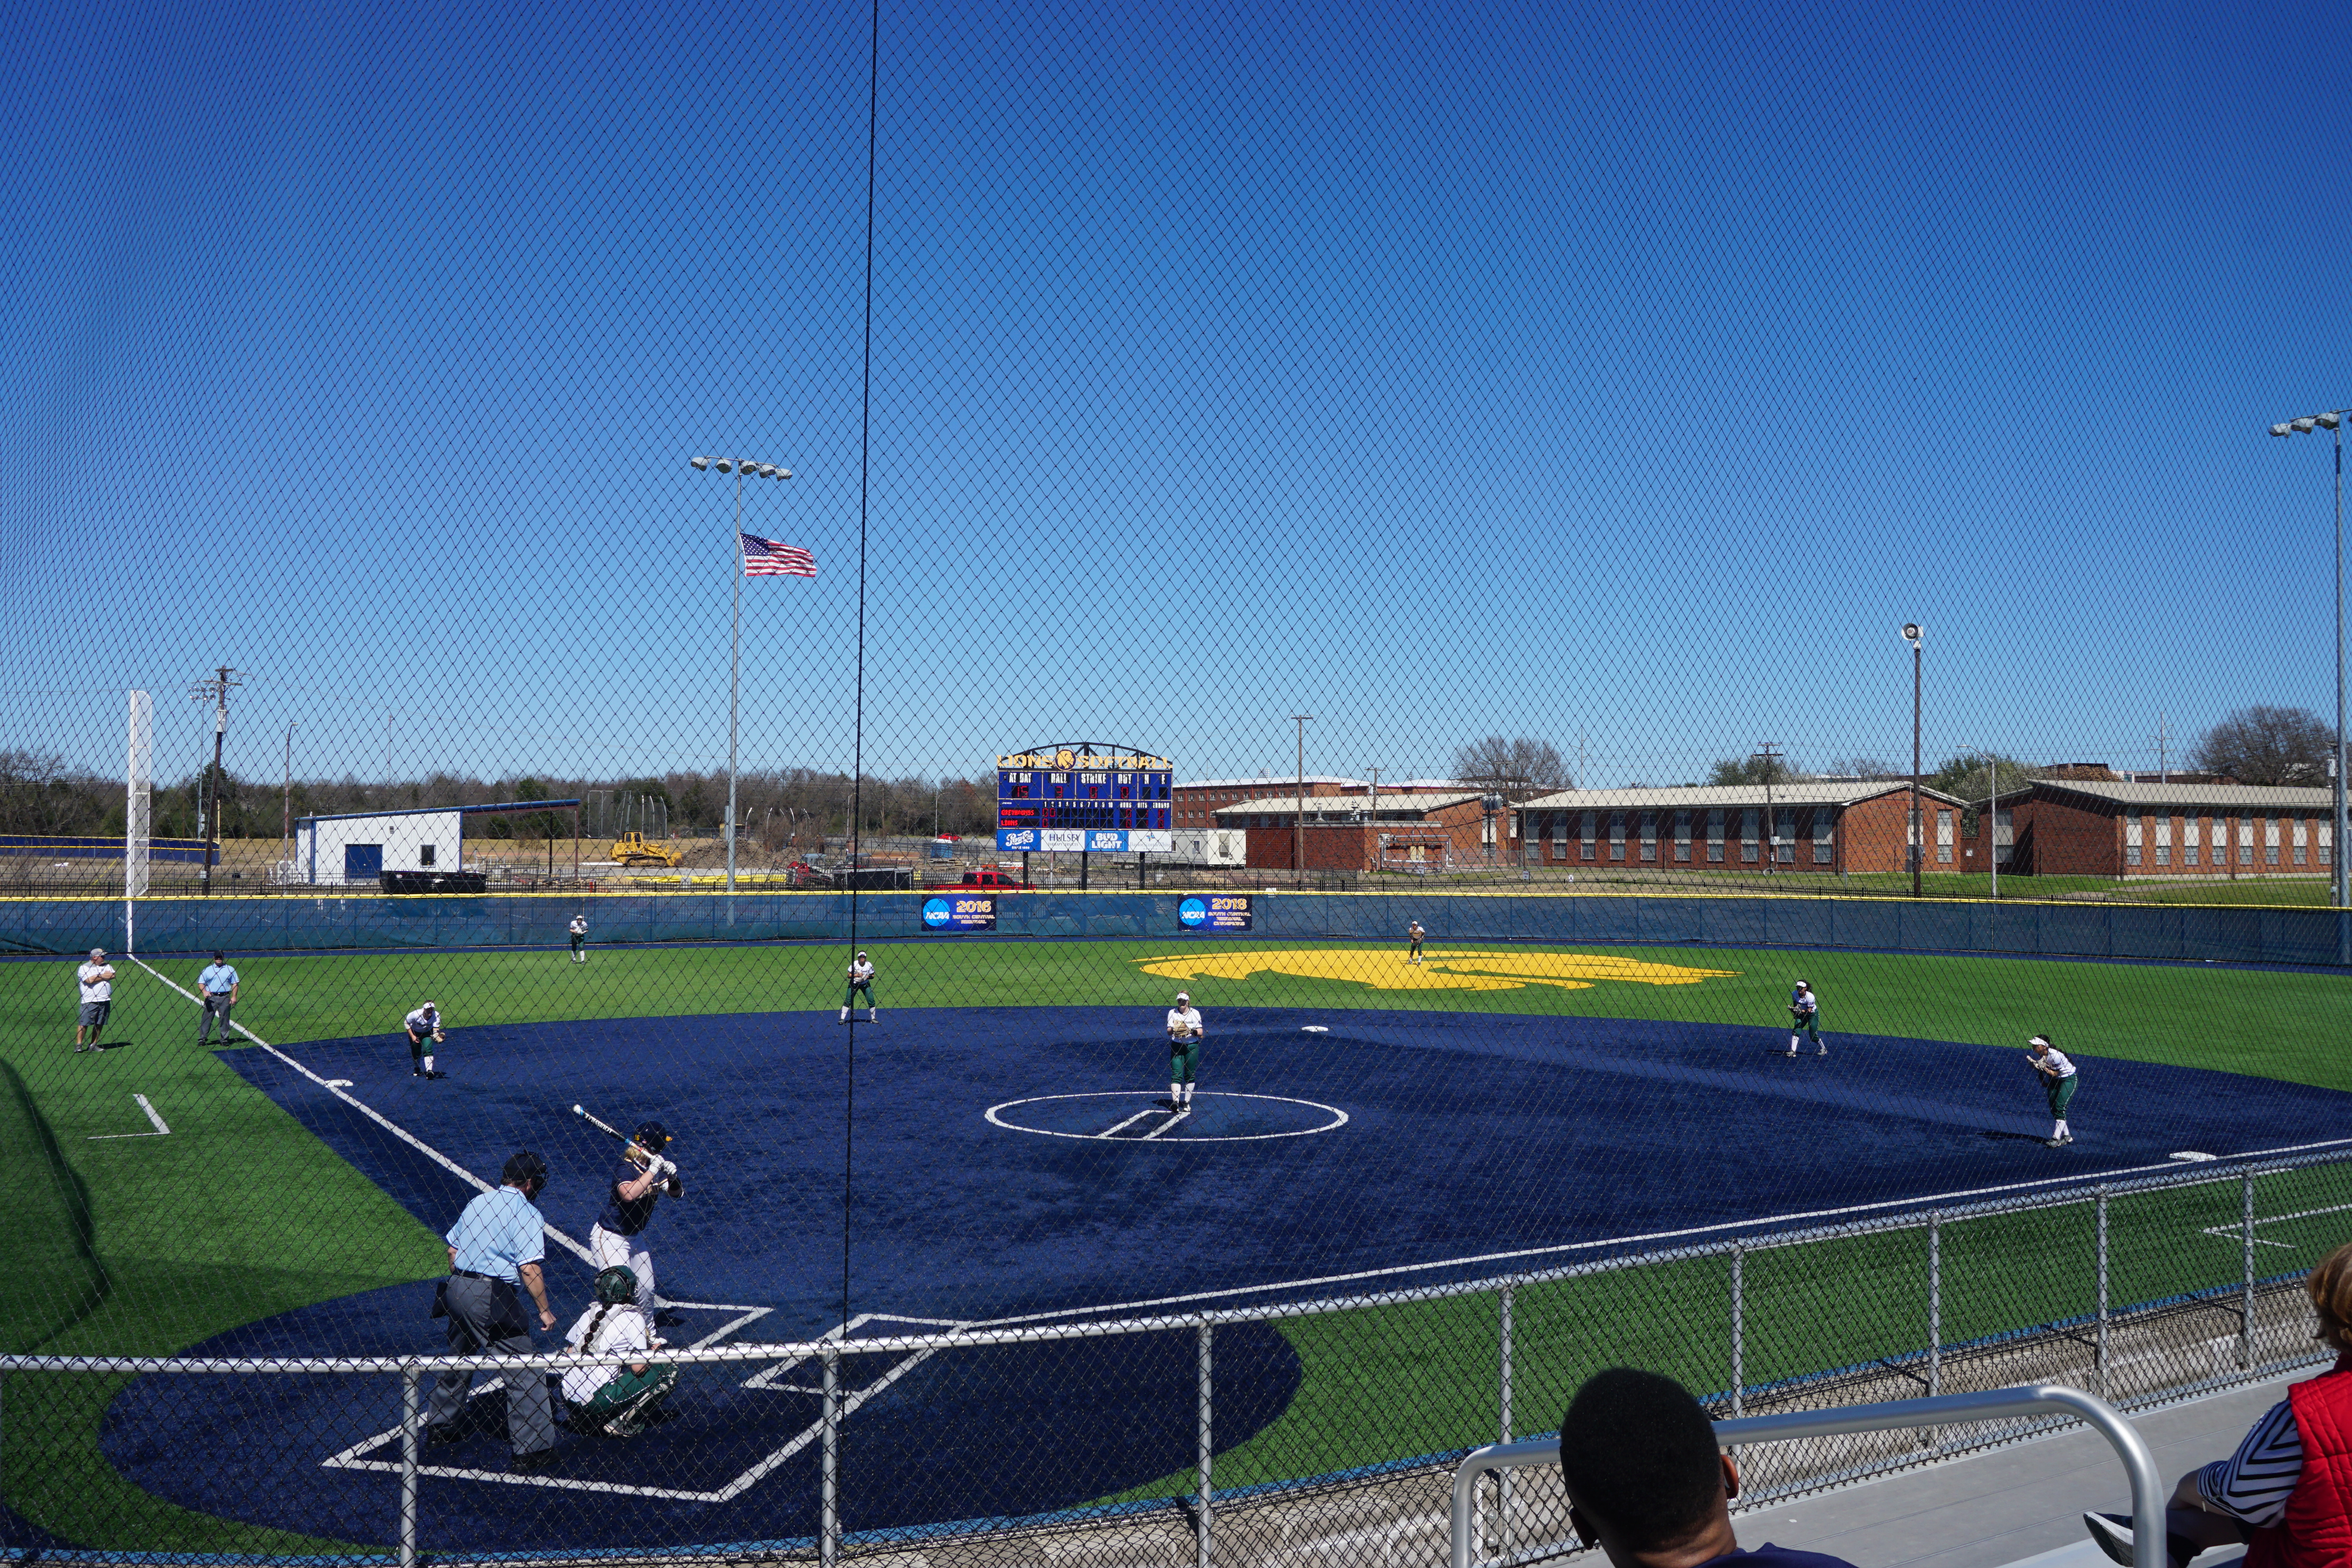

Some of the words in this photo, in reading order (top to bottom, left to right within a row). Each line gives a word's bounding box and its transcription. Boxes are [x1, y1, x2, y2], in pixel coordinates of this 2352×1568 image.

[997, 755, 1054, 767] LIONS
[1077, 755, 1173, 768] SOFTBALL
[1009, 773, 1017, 783] AT
[1020, 773, 1032, 783] BAT
[1051, 773, 1067, 784] BALL
[1081, 773, 1106, 784] STRIKE
[1118, 774, 1132, 784] OUT
[1144, 774, 1149, 784] H
[1161, 774, 1165, 784] E
[1017, 786, 1027, 798] 15
[1056, 786, 1063, 798] 3
[1090, 786, 1097, 799] 0
[1121, 787, 1129, 799] 0
[1043, 808, 1048, 817] 0
[1050, 808, 1055, 817] 0
[1126, 809, 1131, 818] 0
[1158, 809, 1164, 818] 0
[1042, 818, 1048, 828] 0
[1126, 819, 1131, 828] 0
[1158, 820, 1164, 828] 0
[1096, 833, 1118, 841] BUD
[956, 900, 991, 913] 2016
[1212, 898, 1247, 910] 2018
[584, 1112, 613, 1134] LOUISVILLE
